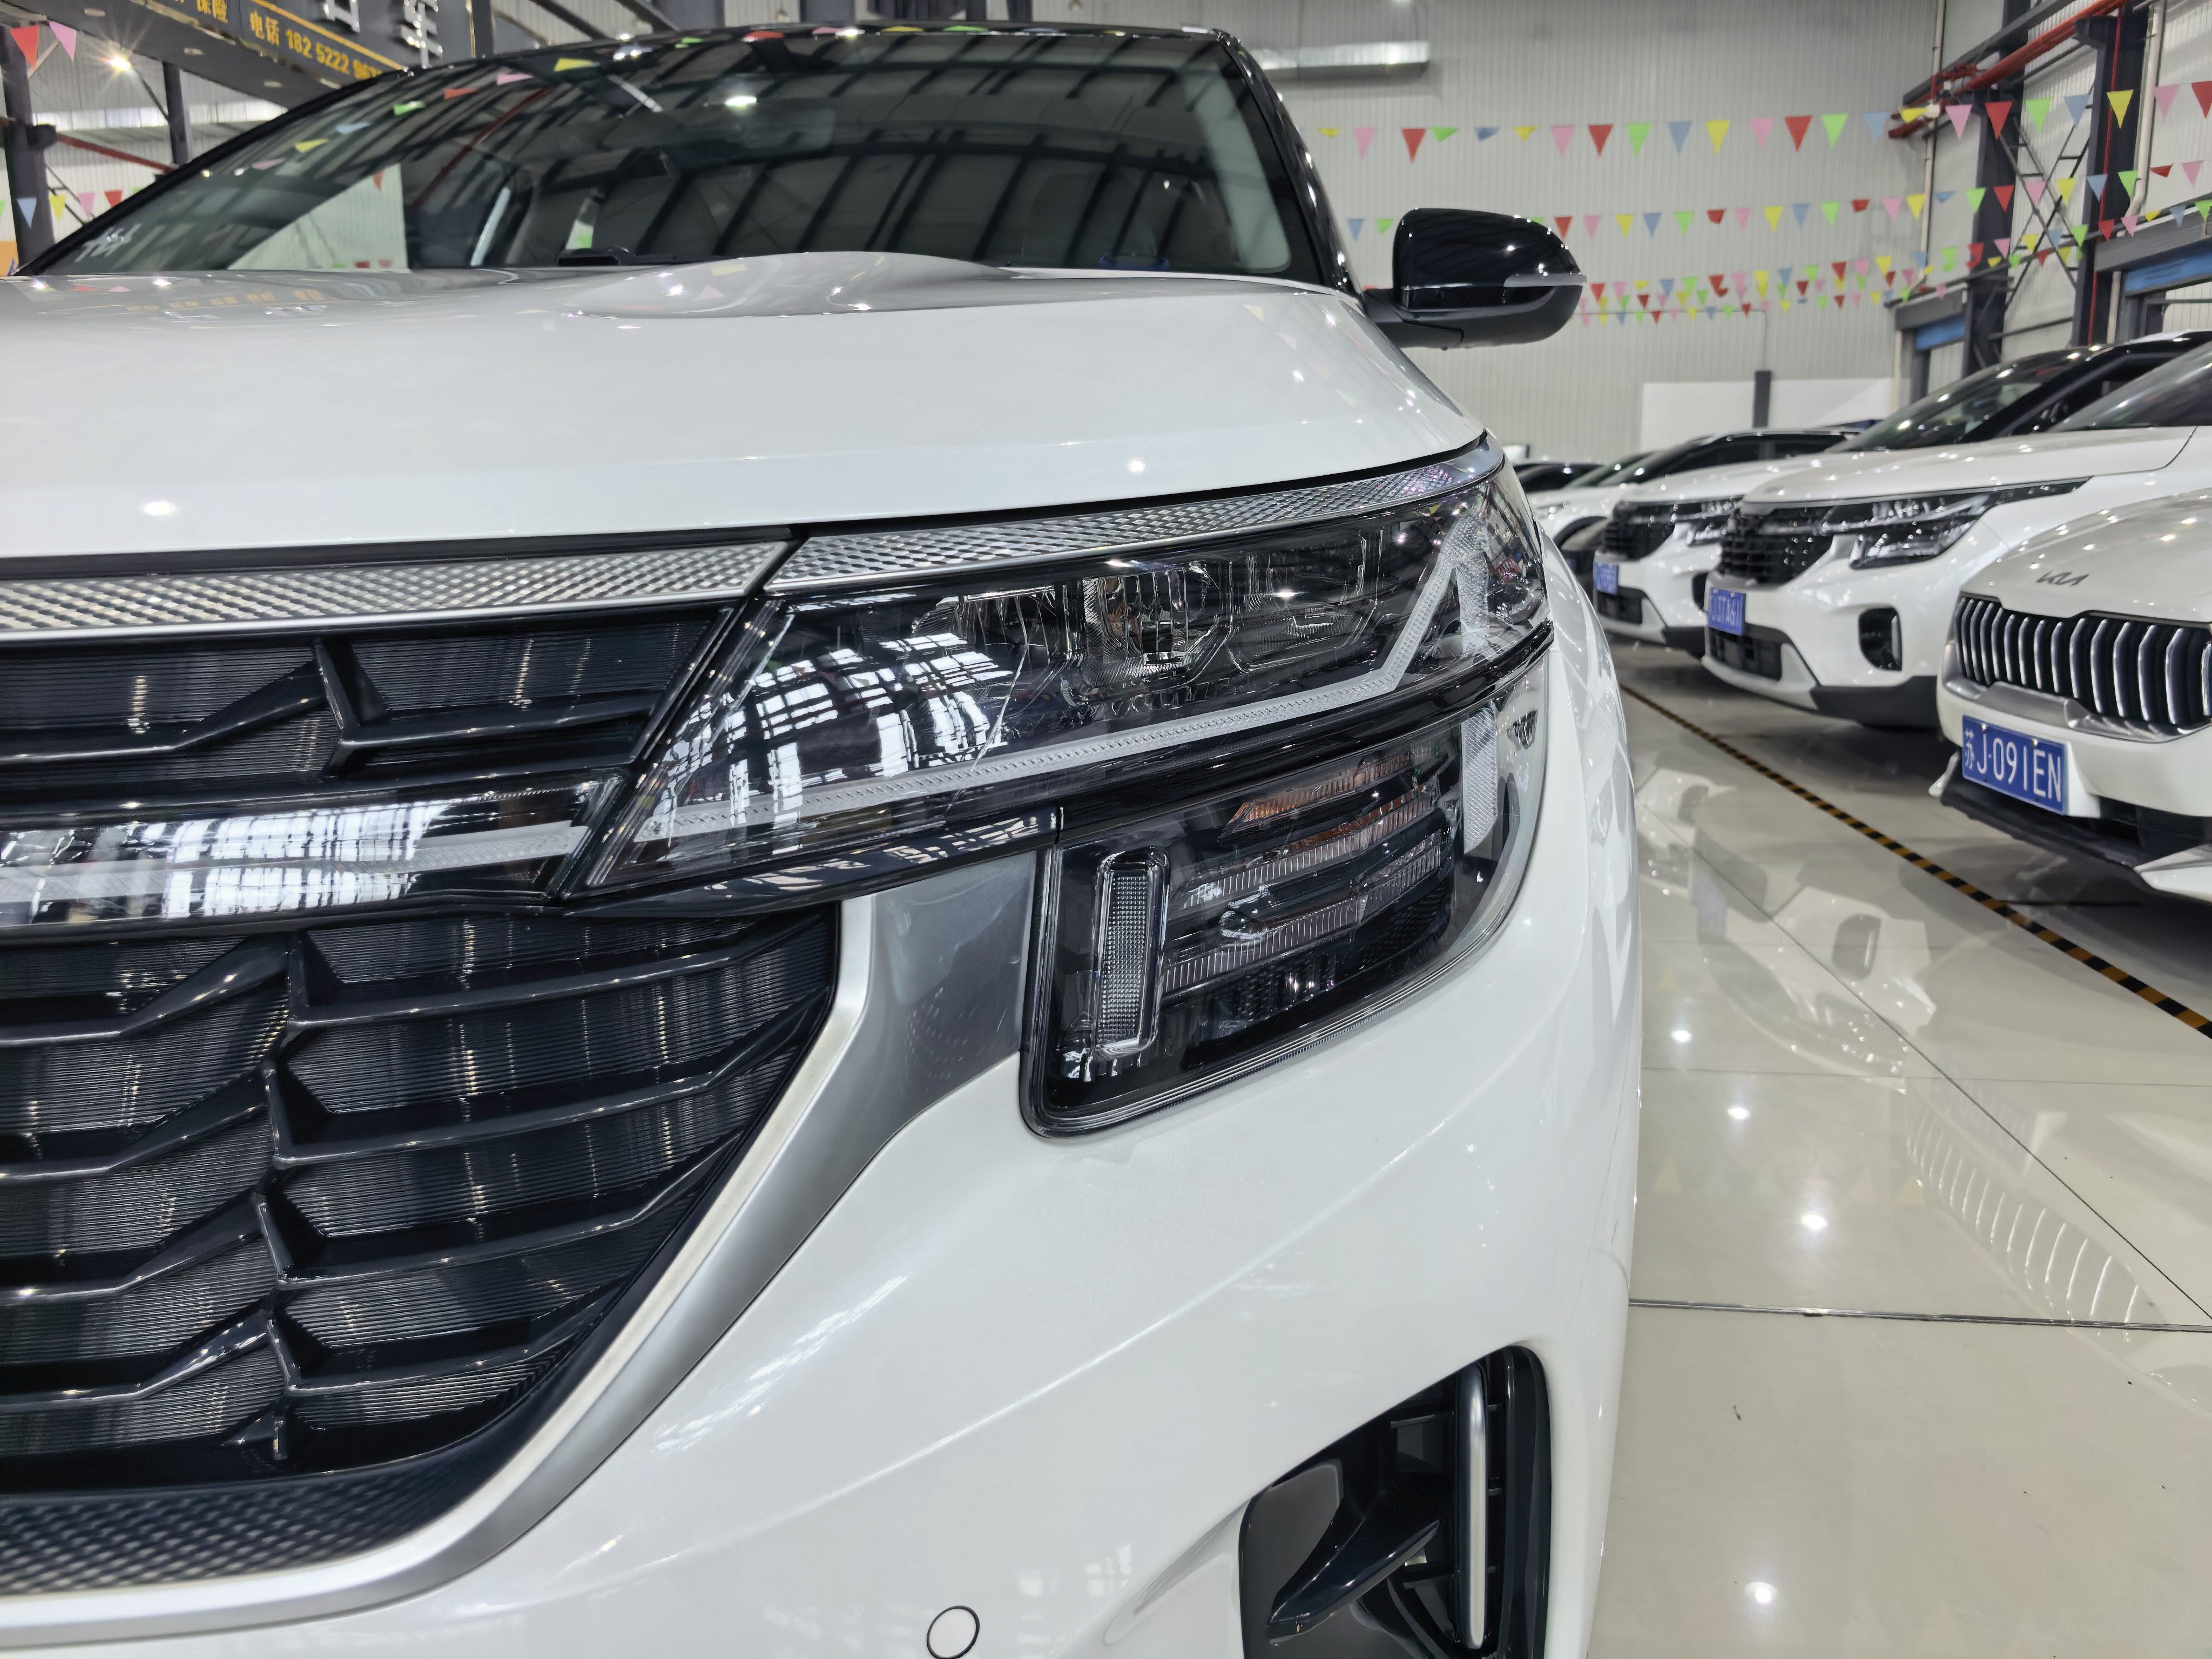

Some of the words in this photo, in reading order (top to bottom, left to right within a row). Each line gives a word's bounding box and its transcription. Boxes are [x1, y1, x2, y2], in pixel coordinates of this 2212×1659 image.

[249, 10, 280, 46] 电话
[285, 29, 312, 59] 182
[316, 42, 350, 76] 5222
